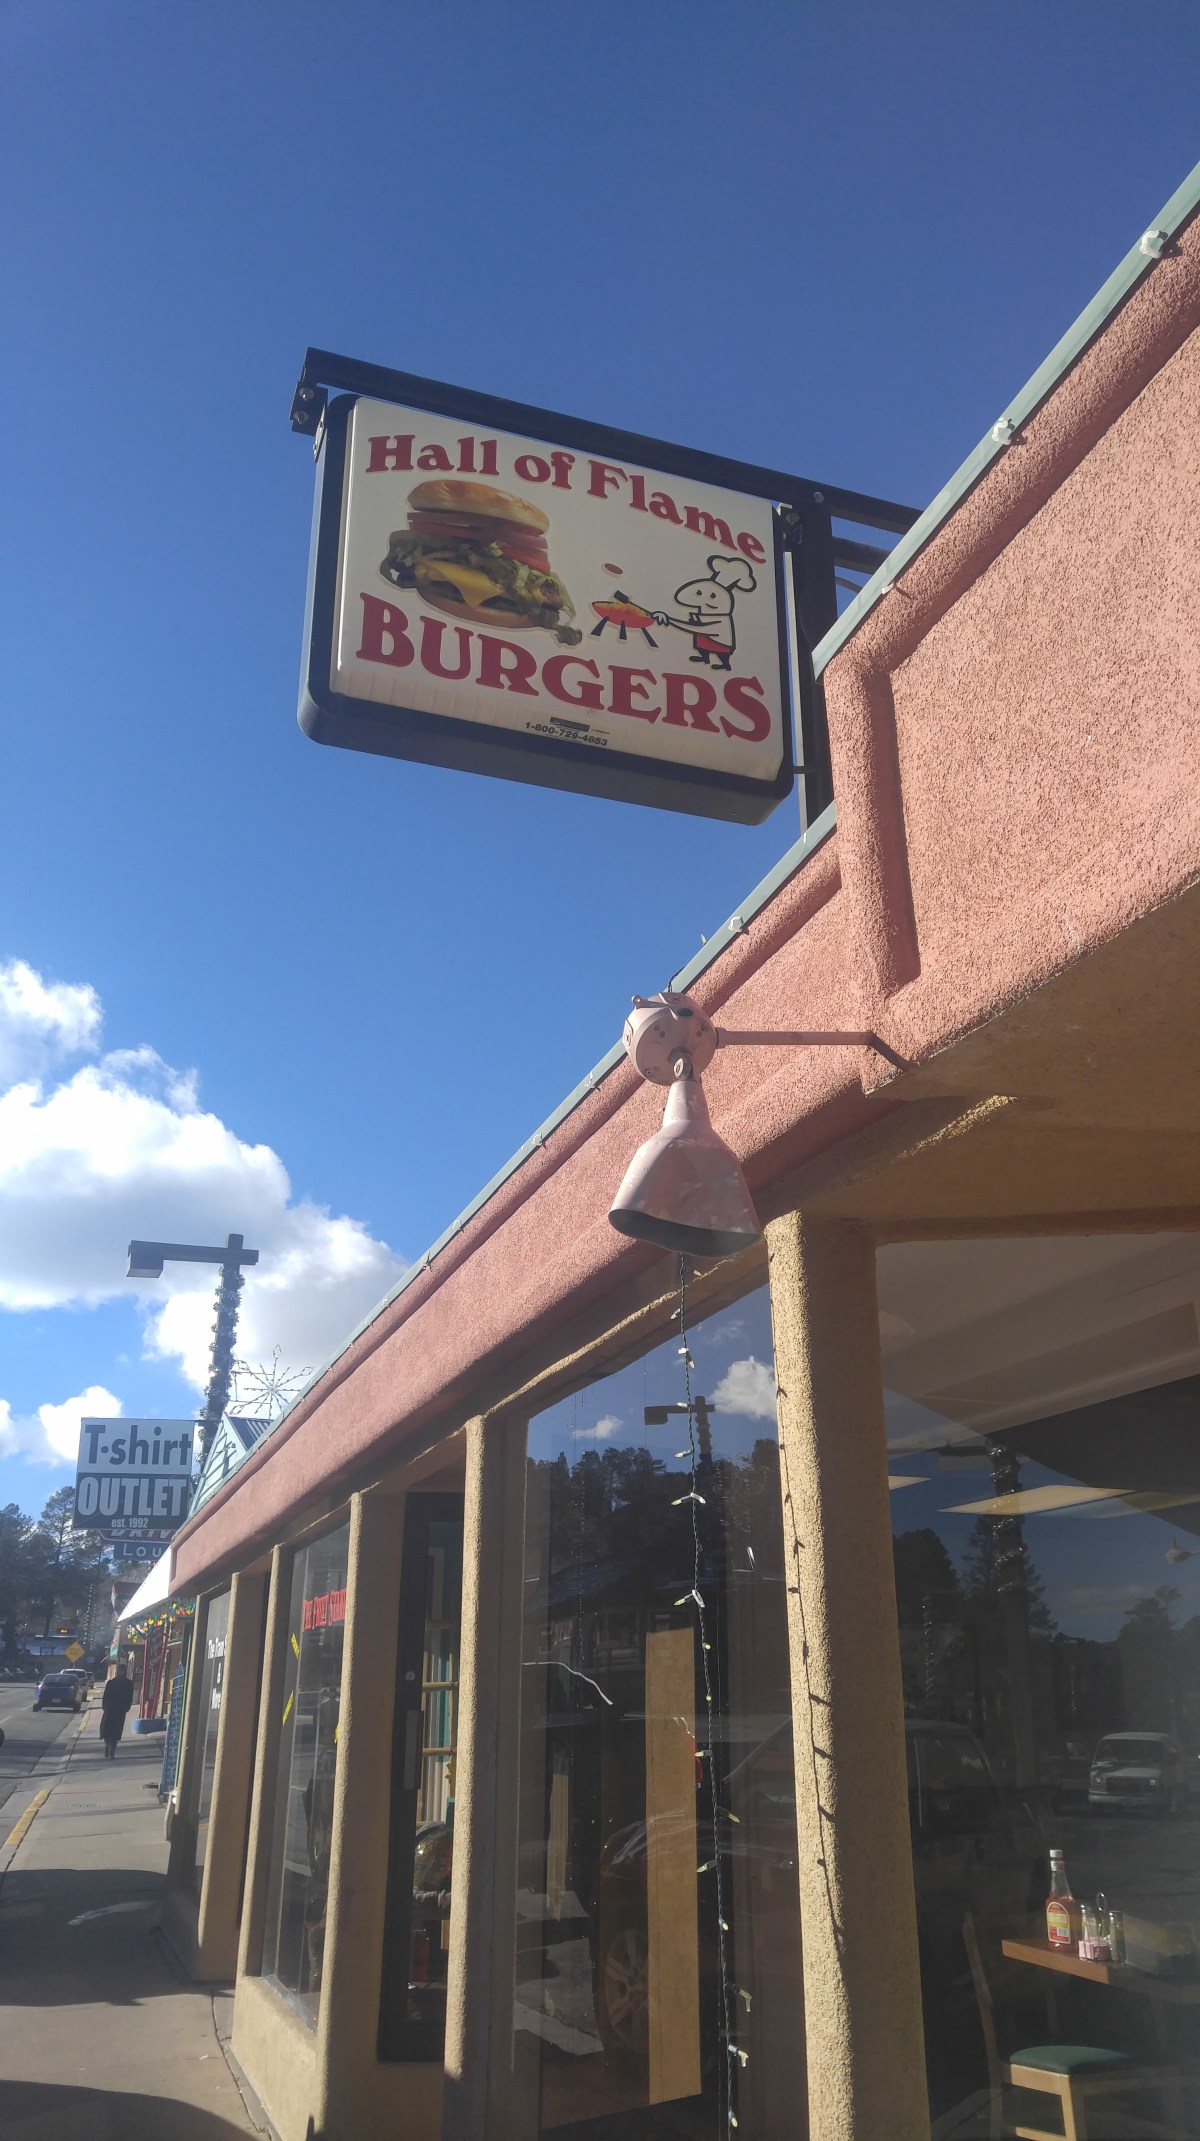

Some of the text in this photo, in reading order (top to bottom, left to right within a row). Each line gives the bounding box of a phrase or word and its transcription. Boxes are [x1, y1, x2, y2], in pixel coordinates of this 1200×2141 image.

[365, 434, 767, 565] Hall of Flame
[355, 592, 771, 742] BURGERS
[525, 722, 608, 746] 1-800-729-4853
[77, 1476, 187, 1517] OUTLET
[111, 1517, 149, 1528] est. 1992
